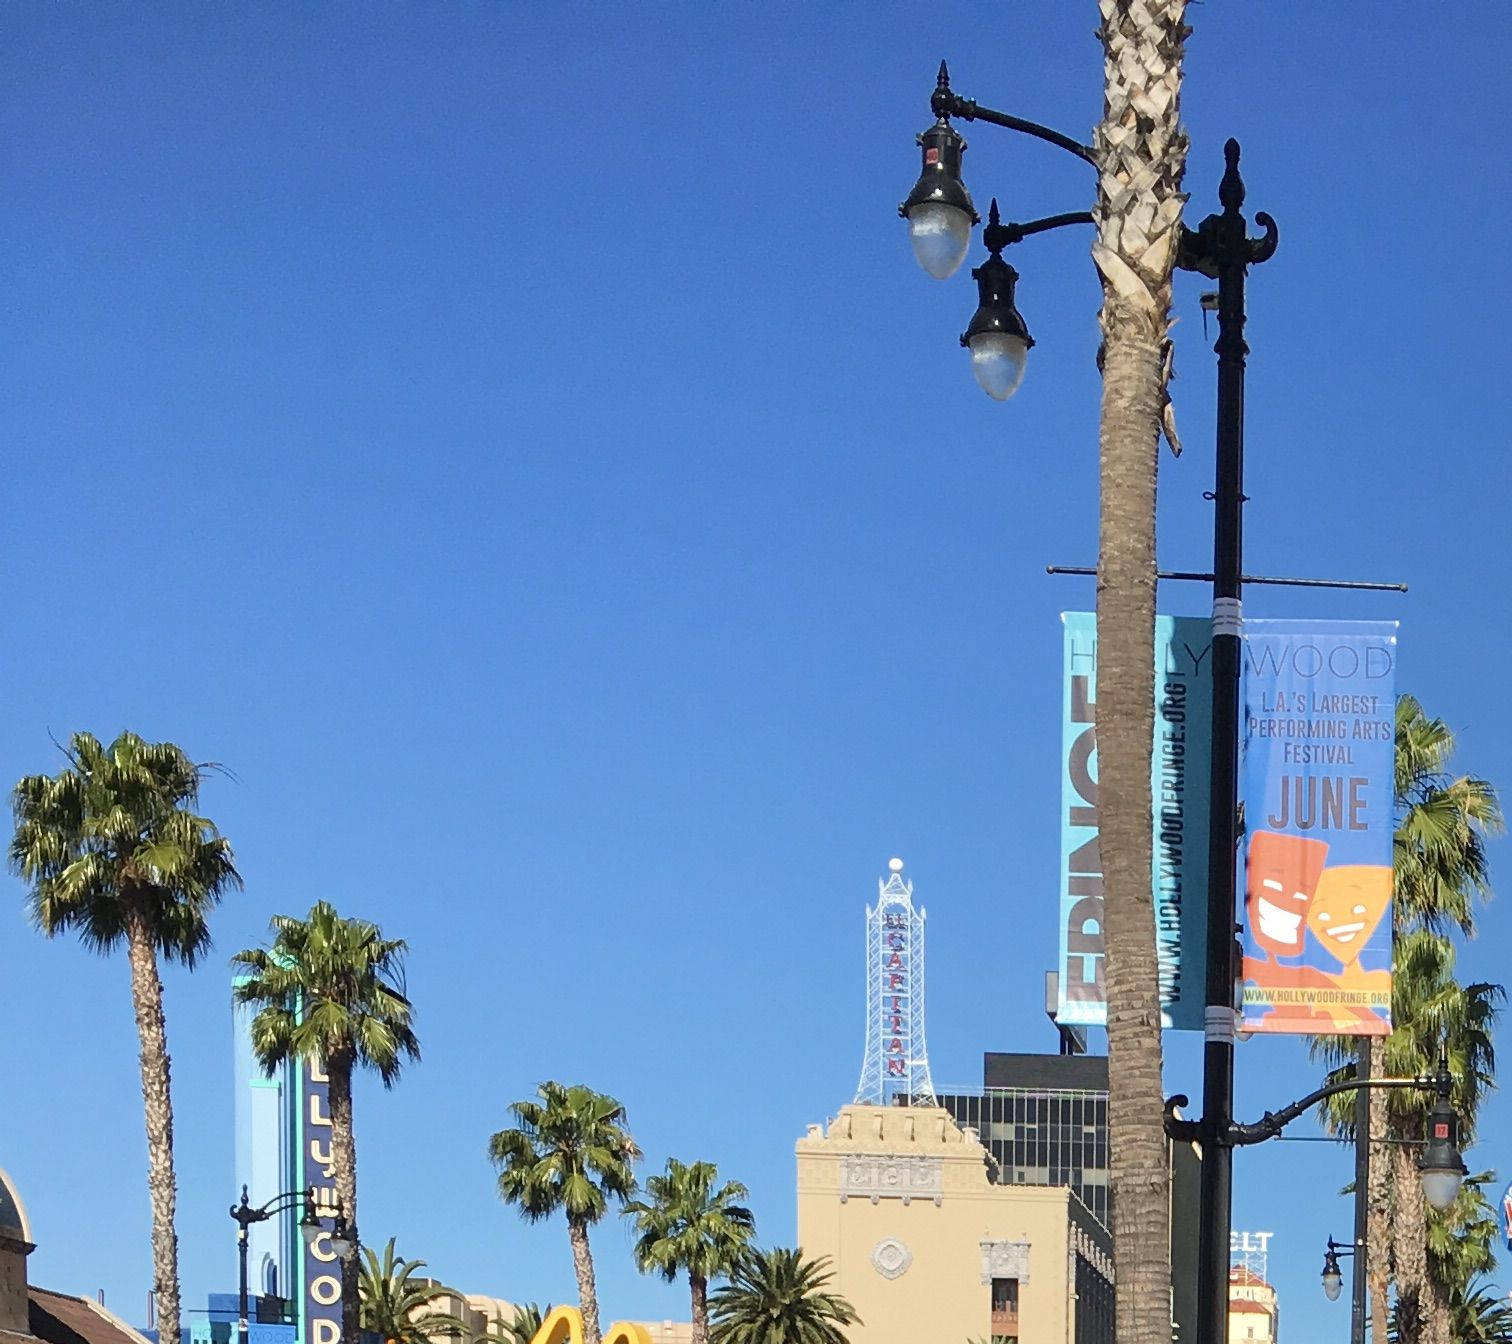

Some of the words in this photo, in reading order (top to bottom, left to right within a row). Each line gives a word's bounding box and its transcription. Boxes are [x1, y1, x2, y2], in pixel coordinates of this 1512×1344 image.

[1070, 637, 1212, 677] HLY
[1246, 644, 1393, 679] WOOD
[1261, 691, 1306, 714] L.A.'S
[1311, 691, 1379, 715] LARGEST
[1249, 717, 1347, 740] PERFORMING
[1352, 718, 1391, 741] ARTS
[1283, 742, 1355, 765] FESTIVAL
[1267, 775, 1369, 831] JUNE
